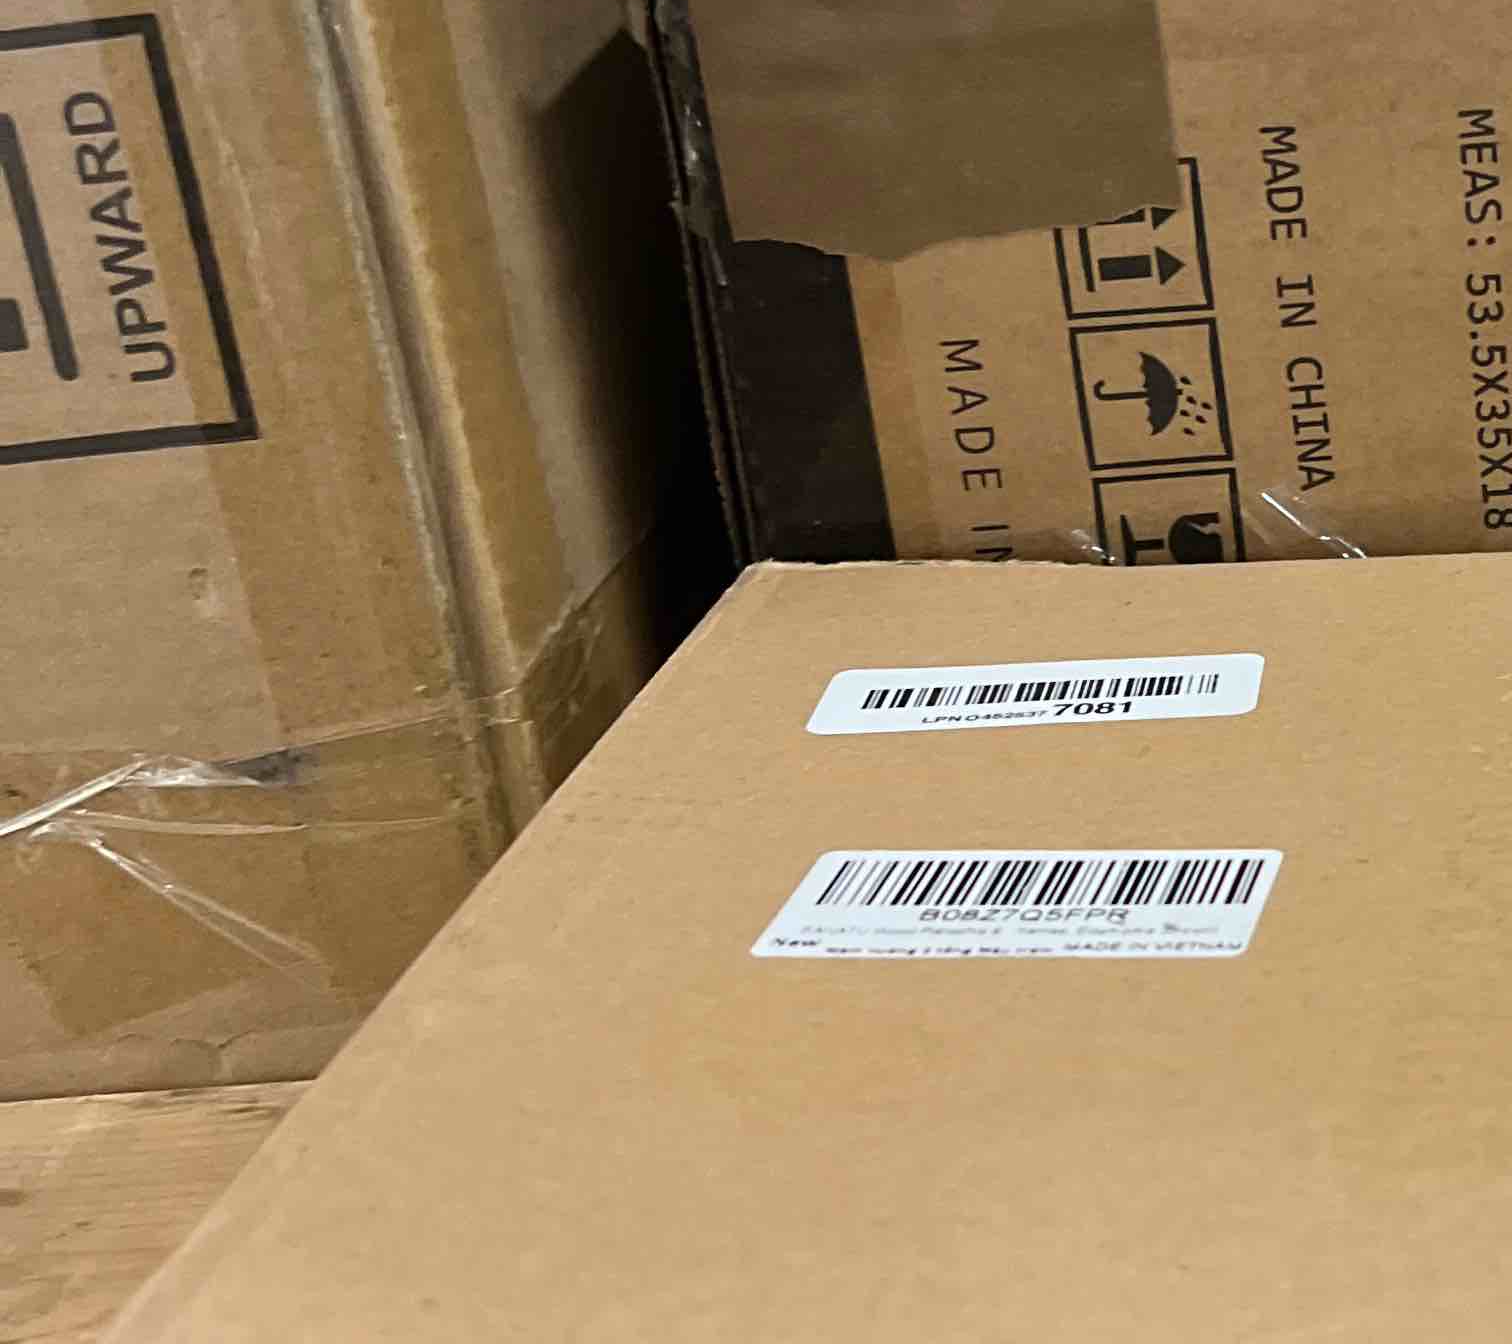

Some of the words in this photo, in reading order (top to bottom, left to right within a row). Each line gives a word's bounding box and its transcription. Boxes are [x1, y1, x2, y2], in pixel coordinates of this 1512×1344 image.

[63, 87, 177, 385] UPWARD
[1260, 125, 1308, 241] MADE
[1458, 108, 1502, 250] MEAS:
[1275, 275, 1318, 329] IN
[938, 338, 1005, 493] MADE
[1284, 356, 1337, 492] CHINA
[1053, 699, 1133, 718] 7081
